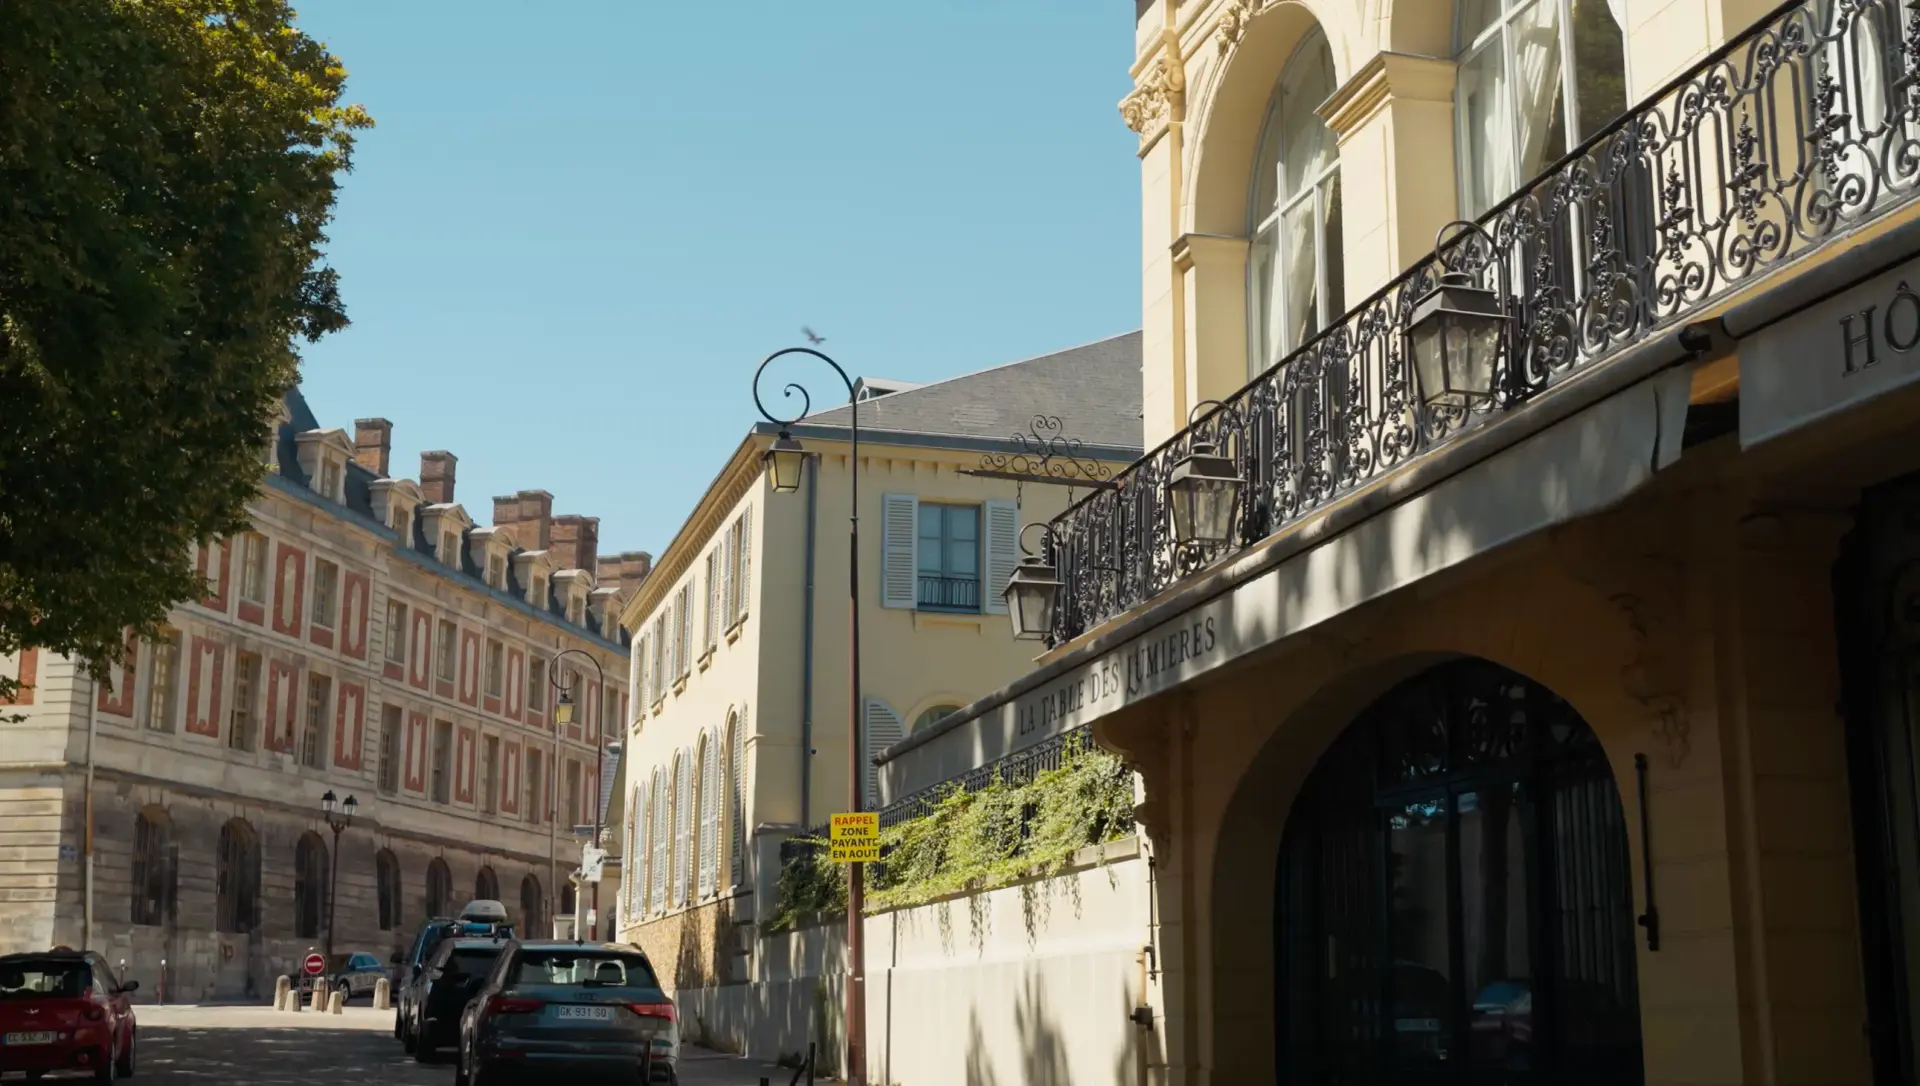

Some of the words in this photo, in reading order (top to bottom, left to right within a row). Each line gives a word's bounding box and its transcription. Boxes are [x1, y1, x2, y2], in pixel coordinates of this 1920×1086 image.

[1020, 706, 1035, 736] LA
[1042, 680, 1084, 726] TABLE
[1090, 663, 1119, 704] DES
[1127, 616, 1215, 694] LUMIERES
[835, 816, 874, 825] RAPPEL
[841, 827, 868, 836] ZONE
[833, 850, 846, 859] EN
[849, 849, 877, 858] AOUT
